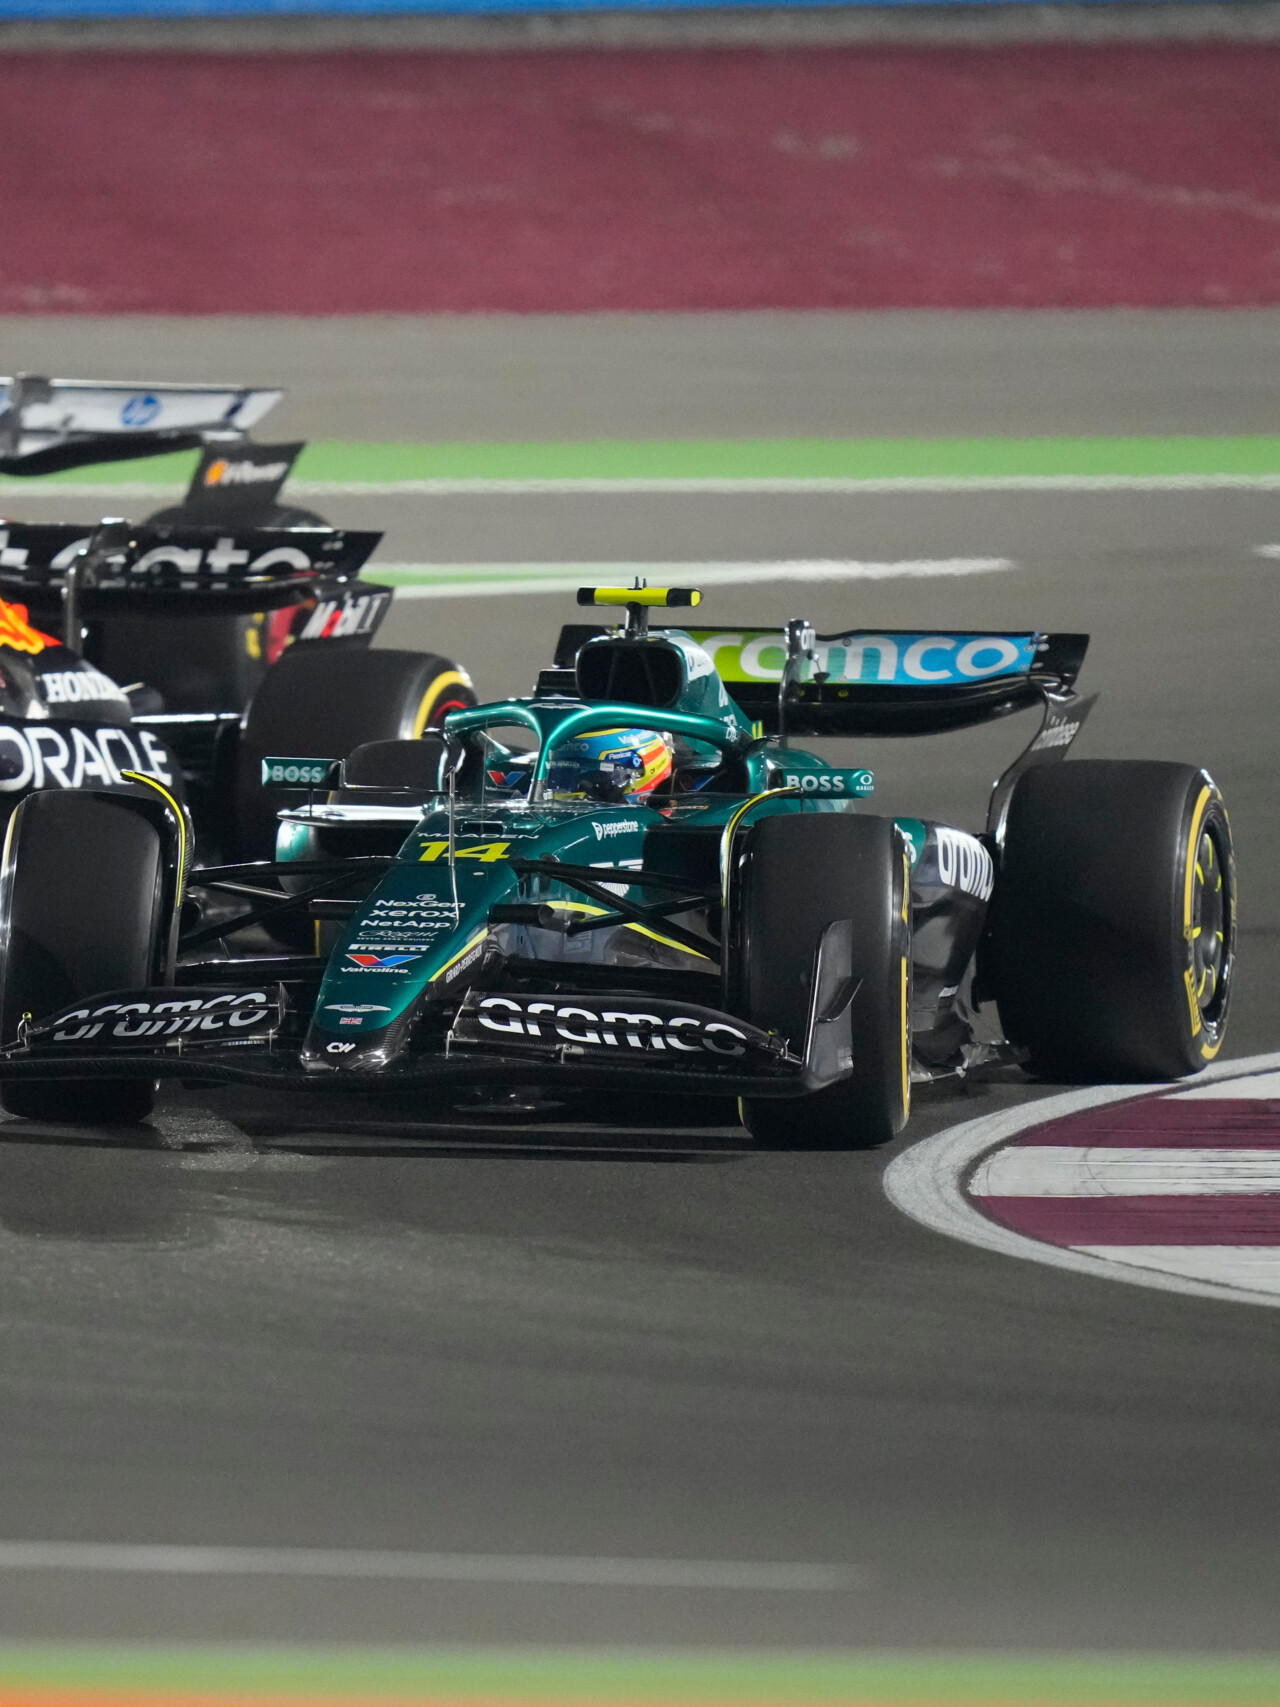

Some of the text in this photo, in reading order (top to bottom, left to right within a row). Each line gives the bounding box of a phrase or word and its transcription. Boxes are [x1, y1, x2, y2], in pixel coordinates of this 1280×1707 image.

[272, 765, 322, 783] BOSS
[786, 774, 846, 793] BOSS
[603, 819, 639, 839] pepperstone
[418, 840, 512, 863] 14
[375, 899, 466, 909] NexGen
[368, 909, 459, 918] xerox
[360, 919, 452, 930] NetApp
[348, 943, 430, 952] PIRELLI
[340, 966, 412, 976] Valvoline
[53, 992, 269, 1041] aramco
[478, 997, 747, 1056] aramco
